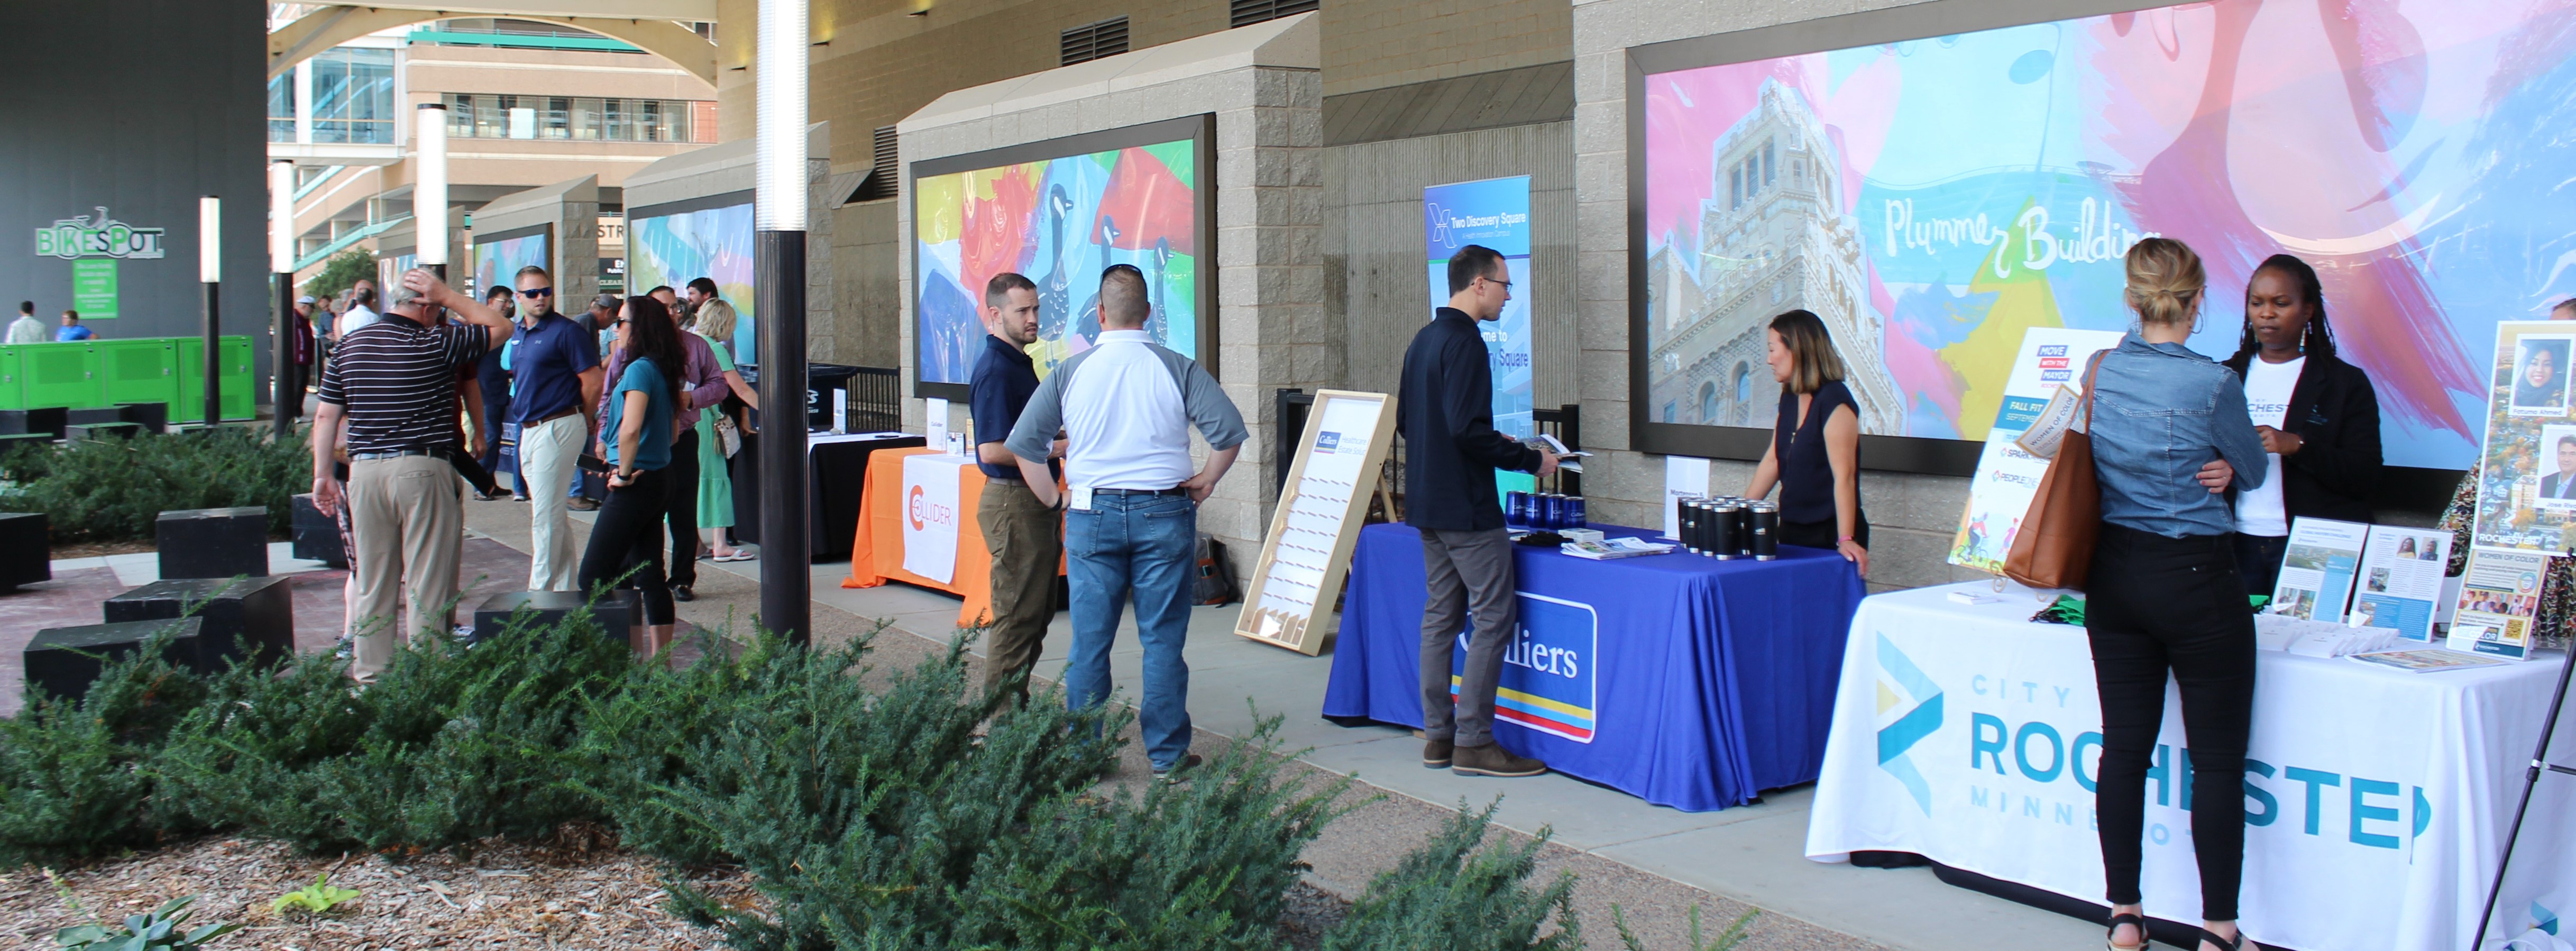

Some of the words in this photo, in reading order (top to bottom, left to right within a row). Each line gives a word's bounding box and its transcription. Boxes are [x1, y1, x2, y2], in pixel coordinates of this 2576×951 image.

[1451, 217, 1465, 229] Two
[1466, 215, 1500, 228] Discovery
[1500, 212, 1526, 227] Square
[37, 228, 163, 253] BIKESPOT
[2017, 196, 2162, 270] Buildin
[1498, 329, 1508, 342] to
[1499, 348, 1528, 372] Square
[2039, 346, 2065, 355] MOVE
[2042, 371, 2070, 380] MAYOR
[2009, 401, 2029, 411] FALL
[2030, 403, 2045, 413] FIT
[2030, 425, 2055, 446] WOMEN
[2052, 415, 2062, 426] OF
[2059, 396, 2075, 417] COLOR
[909, 484, 952, 532] COLLIDER
[1458, 622, 1578, 679] liers
[1972, 674, 2071, 709] CITY
